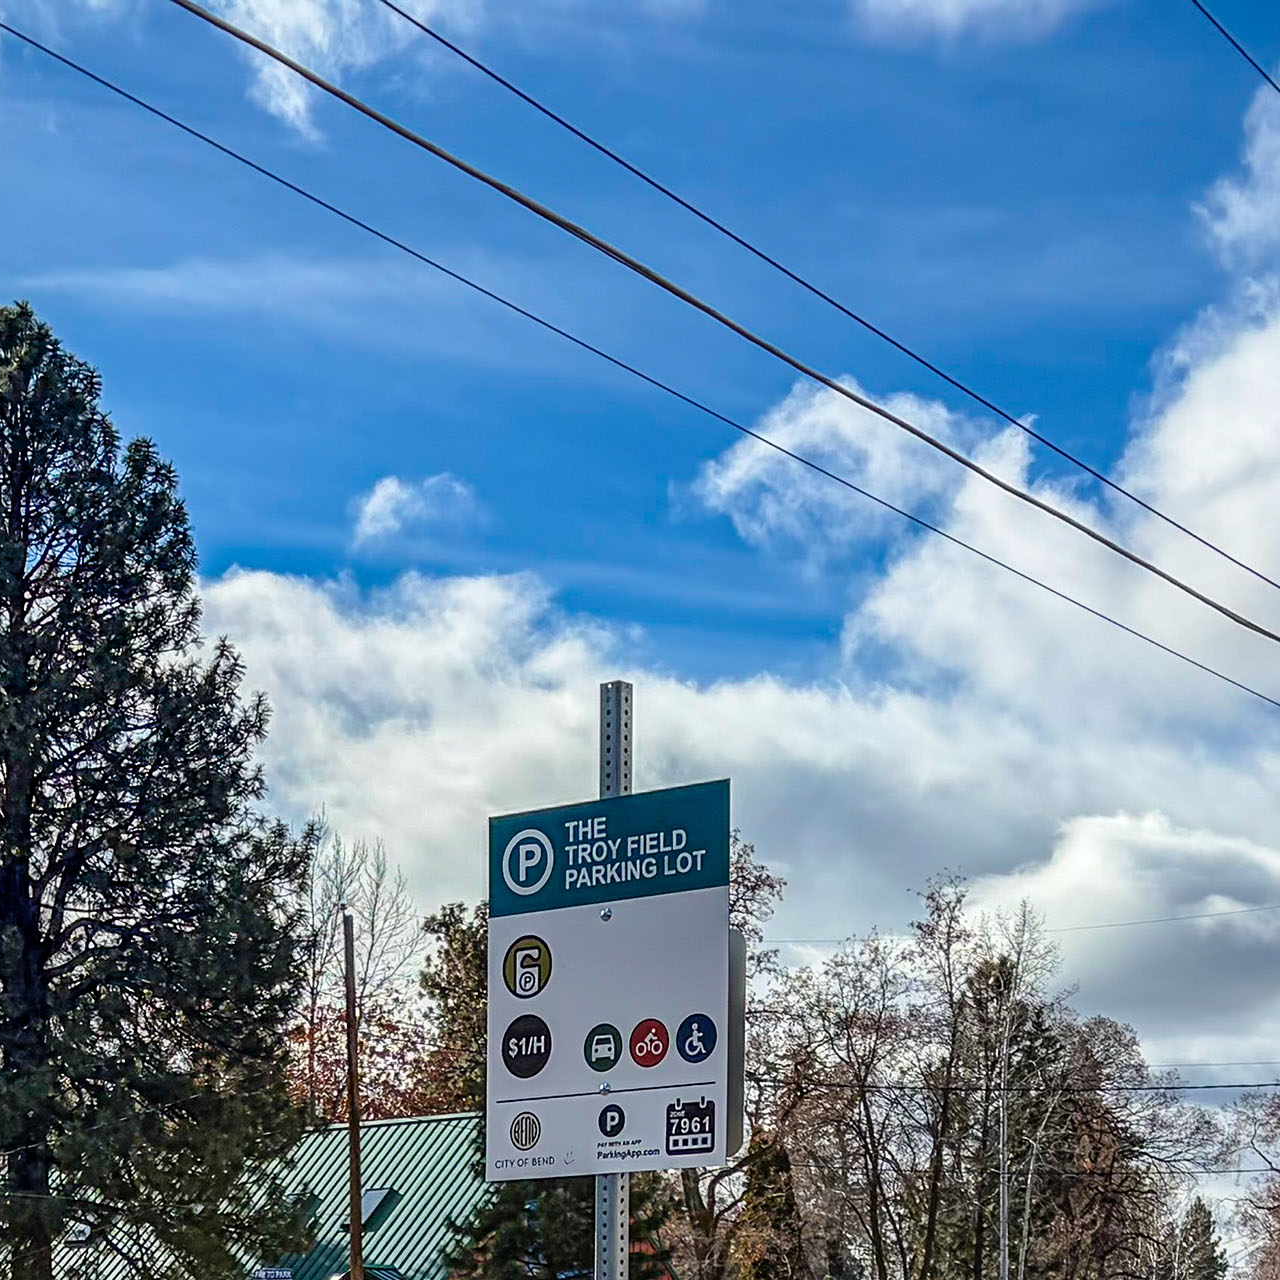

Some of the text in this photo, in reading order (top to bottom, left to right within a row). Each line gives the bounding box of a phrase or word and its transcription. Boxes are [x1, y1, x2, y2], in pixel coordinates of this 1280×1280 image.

[565, 817, 607, 842] THE
[564, 829, 687, 866] TROY FIELD
[519, 844, 542, 882] P
[565, 850, 706, 890] PARKING LOT
[508, 1035, 545, 1058] $1/H
[606, 1111, 619, 1132] P
[670, 1116, 709, 1134] 7961
[495, 1156, 555, 1169] CITY OF BEND
[597, 1149, 660, 1160] ParkingApp.com
